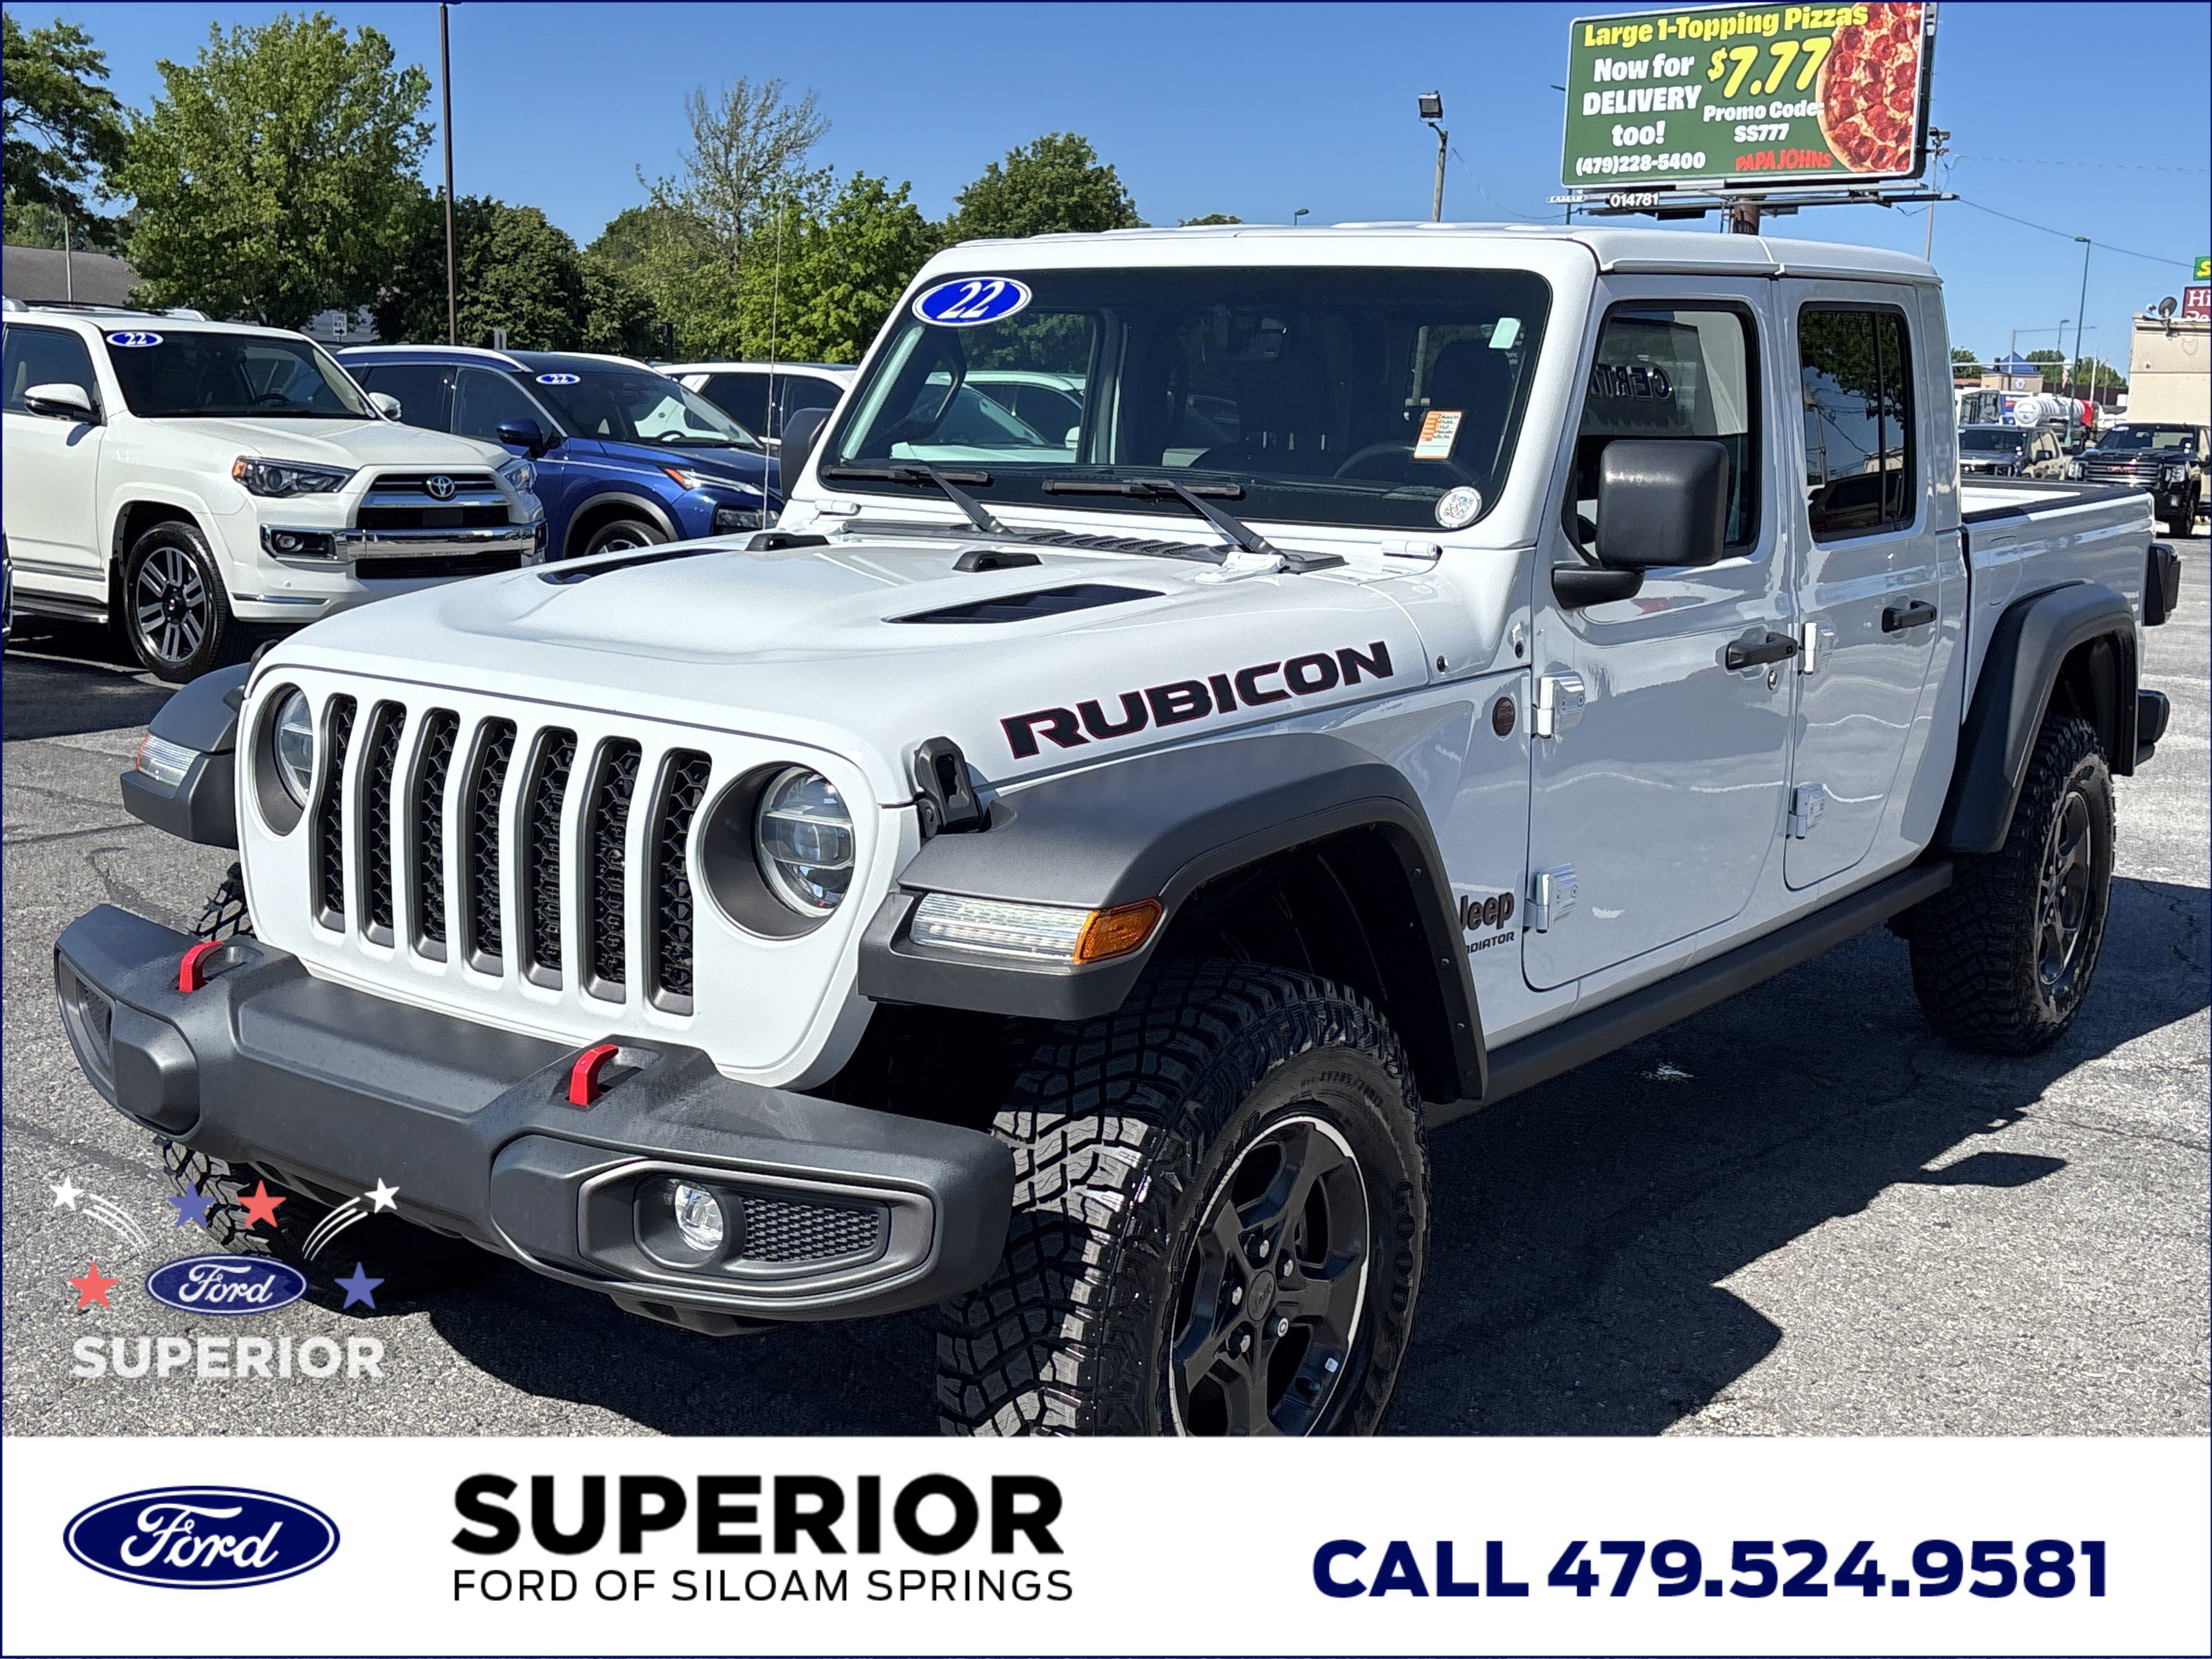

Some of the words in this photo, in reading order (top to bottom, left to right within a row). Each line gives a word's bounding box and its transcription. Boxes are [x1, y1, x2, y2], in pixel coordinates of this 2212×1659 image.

[1584, 24, 1653, 48] Large
[1657, 12, 1780, 42] 1-Topping
[1784, 6, 1868, 31] Pizzas
[1594, 58, 1649, 82] Now
[1652, 53, 1695, 77] for
[1707, 37, 1832, 98] $7.77
[1582, 84, 1702, 116] DELIVERY
[1703, 105, 1767, 122] Promo
[1769, 99, 1825, 119] Code:
[1612, 120, 1666, 146] too!
[1734, 123, 1790, 143] SS777
[1576, 151, 1706, 176] (479)228-5400
[1735, 150, 1775, 171] PAPA
[1775, 148, 1832, 170] JOHNS
[1610, 192, 1660, 207] 014781
[936, 281, 1005, 319] 22
[124, 332, 147, 345] 22
[550, 374, 568, 383] 22
[999, 640, 1394, 760] RUBICON
[1459, 891, 1515, 932] Jeep
[1465, 931, 1515, 955] DIATOR
